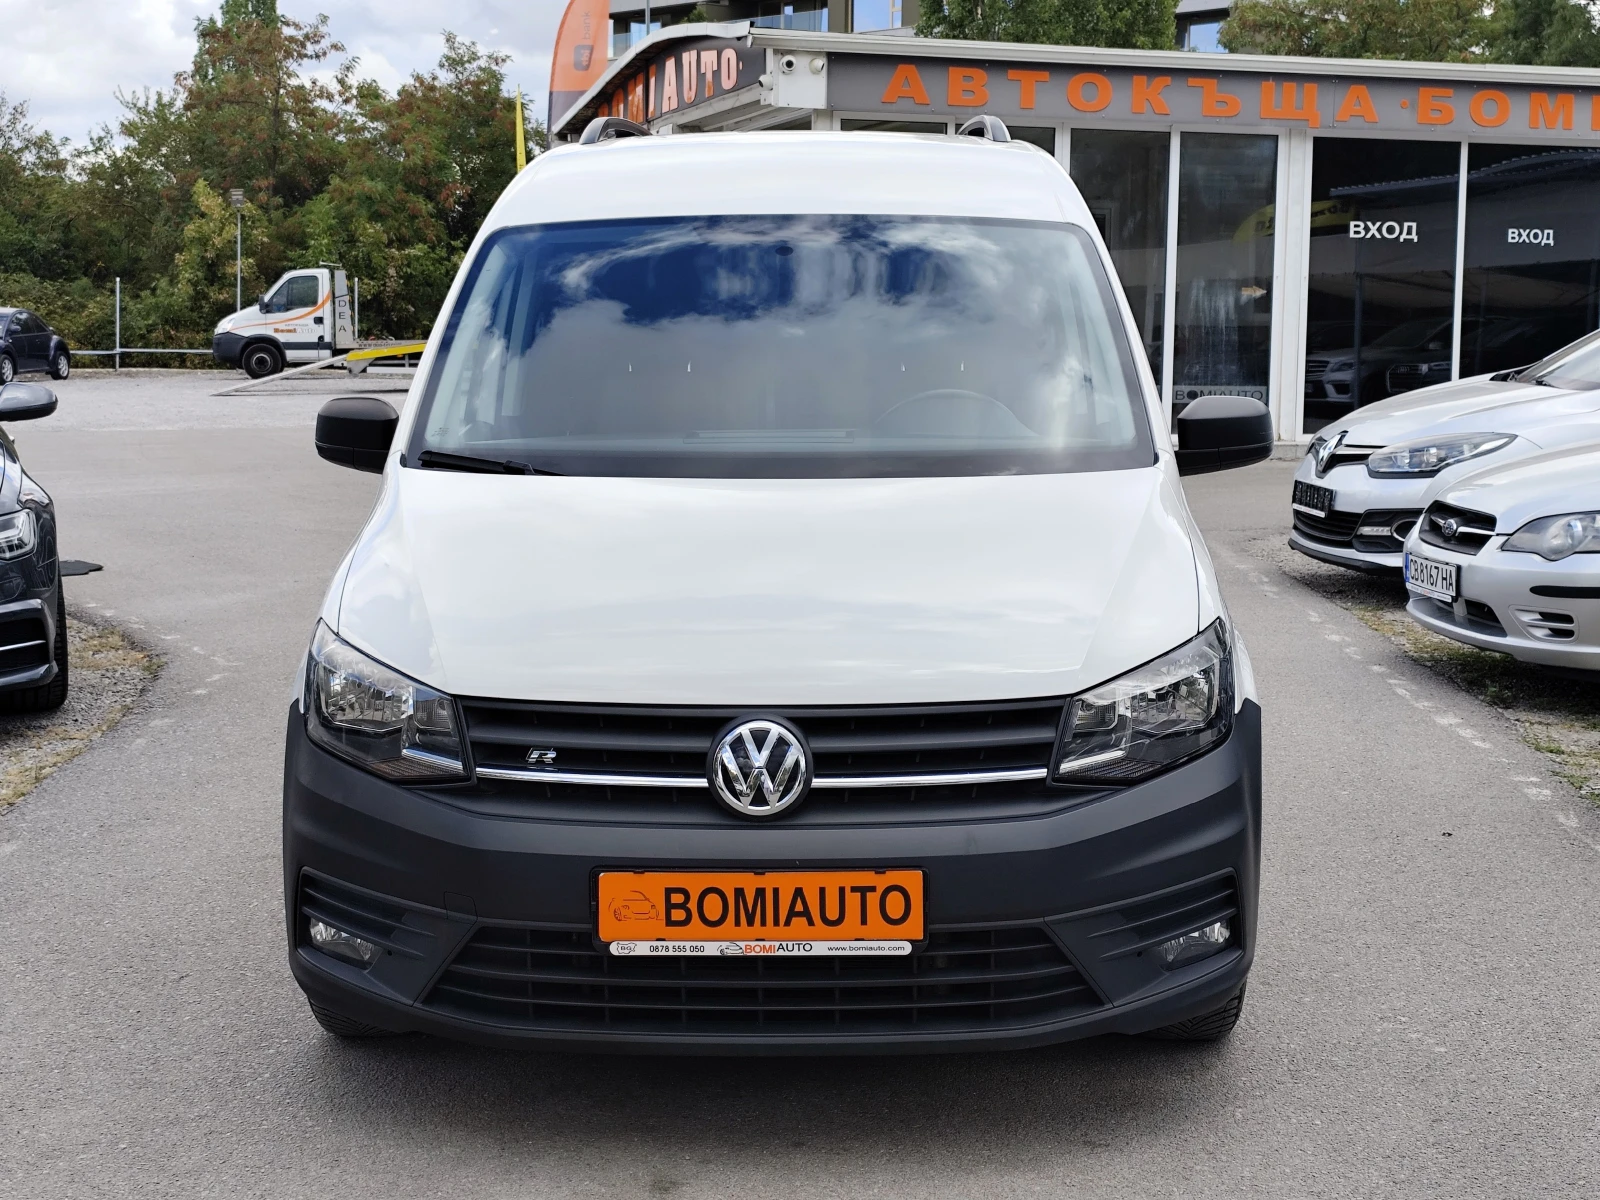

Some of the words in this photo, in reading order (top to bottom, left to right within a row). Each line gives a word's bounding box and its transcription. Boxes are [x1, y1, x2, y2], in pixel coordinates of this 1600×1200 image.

[581, 11, 591, 40] bank
[1417, 87, 1600, 131] БОМ
[1350, 221, 1418, 242] ВХОД
[1508, 228, 1554, 246] ВХОД
[1420, 562, 1440, 587] 8167
[1441, 567, 1454, 592] HA
[527, 747, 557, 763] R
[664, 884, 911, 927] BOMIAUTO
[649, 945, 670, 953] 0878
[672, 945, 687, 953] 555
[689, 945, 705, 953] 050
[744, 942, 813, 954] BOMIAUTO
